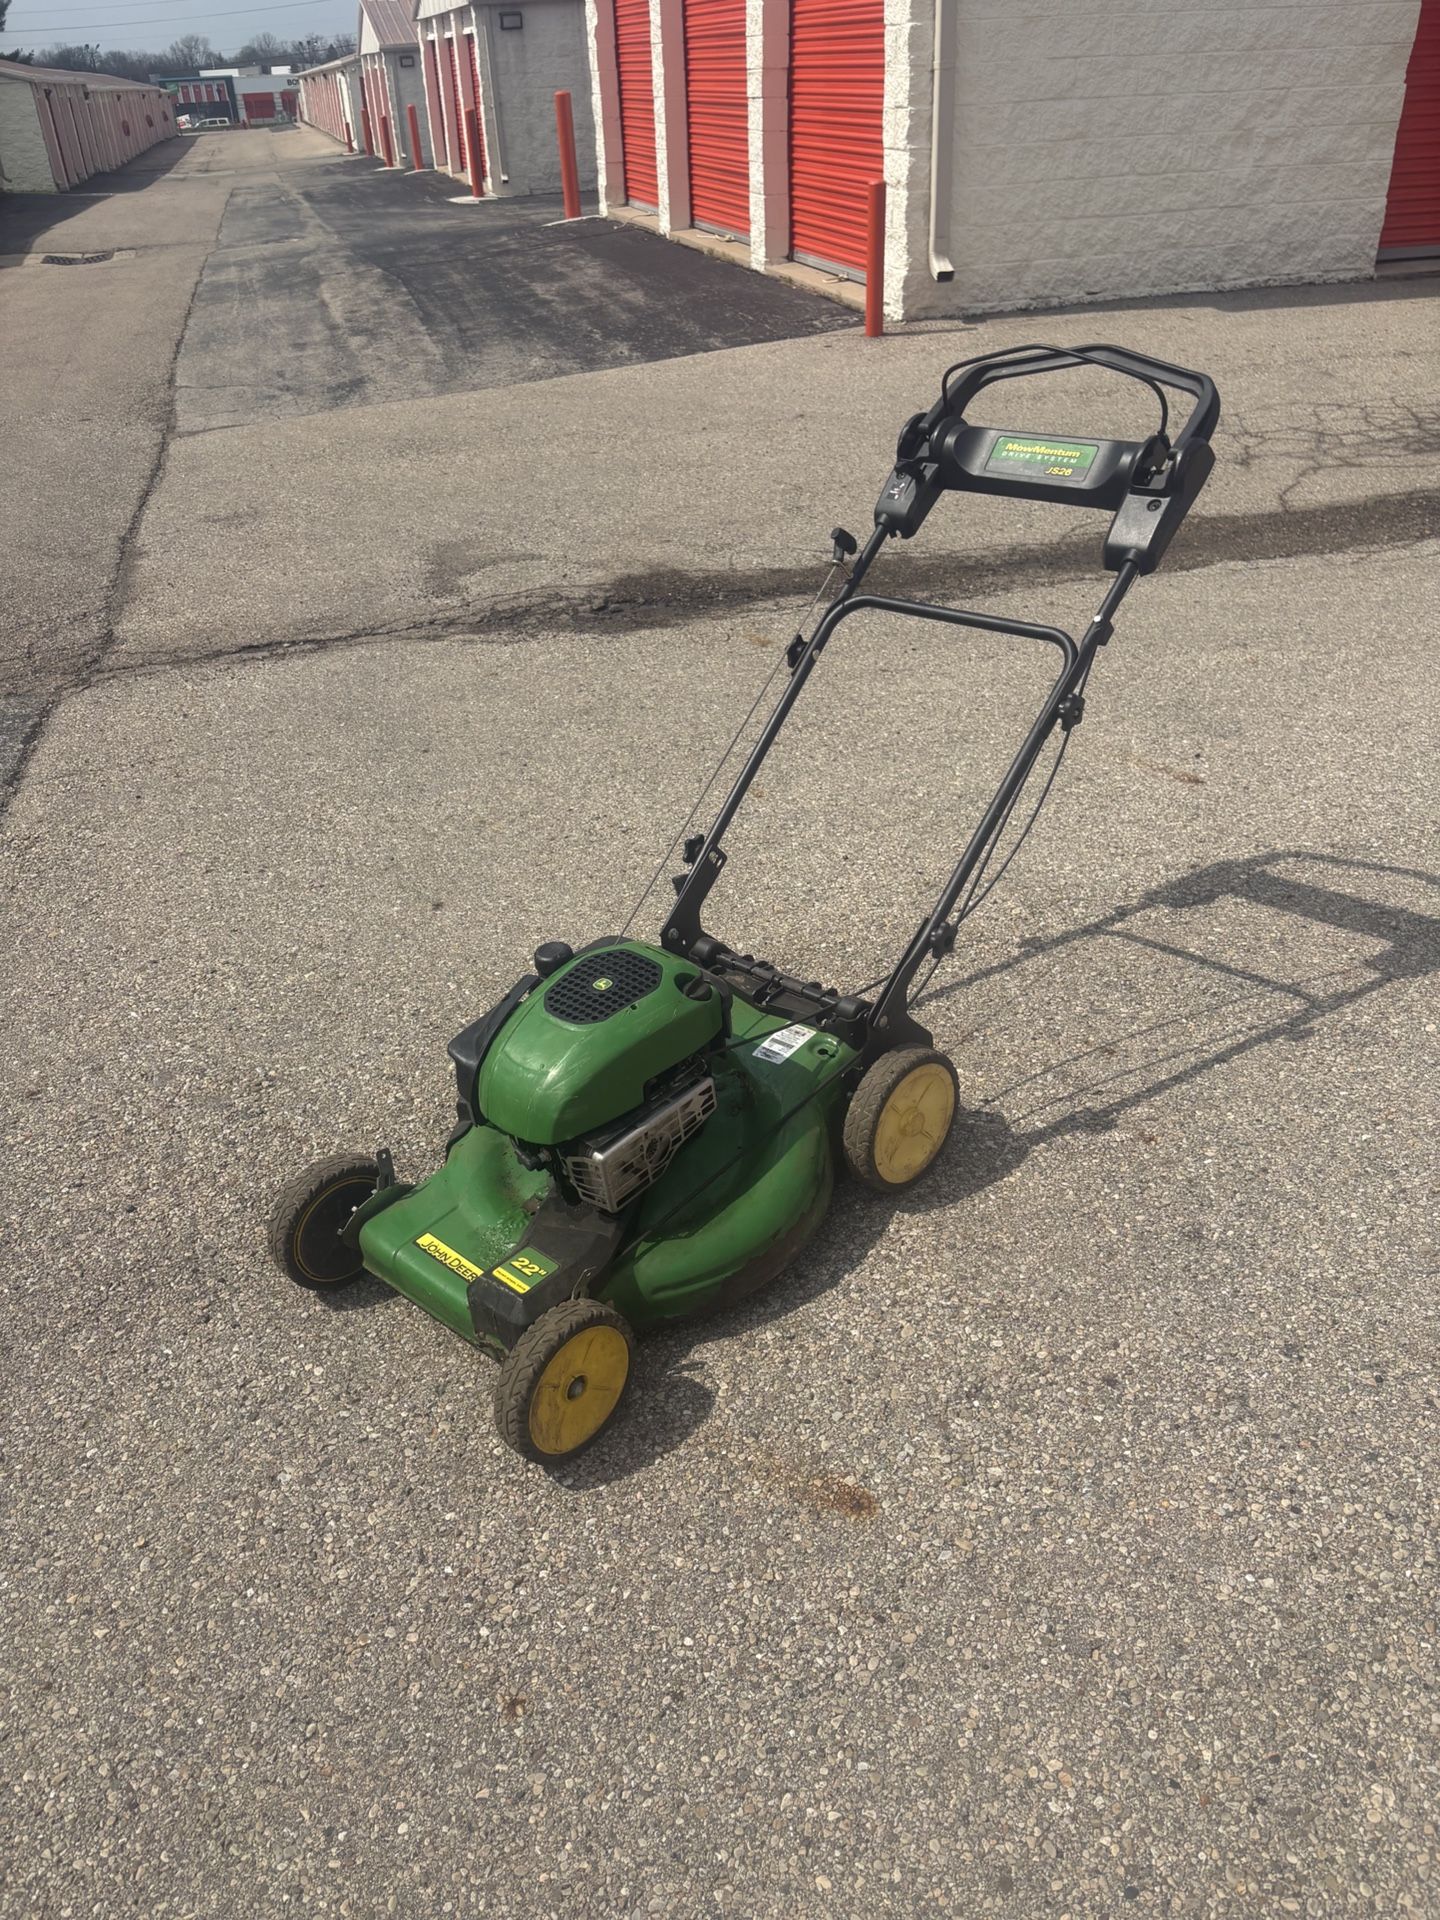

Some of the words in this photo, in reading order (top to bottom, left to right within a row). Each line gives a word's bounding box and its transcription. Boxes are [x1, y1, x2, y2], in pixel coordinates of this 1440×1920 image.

[1005, 443, 1080, 457] MowMentum
[1037, 454, 1078, 463] SYSTEM
[1044, 466, 1073, 476] JS26
[421, 1241, 452, 1262] JOHN
[448, 1257, 479, 1281] DEER
